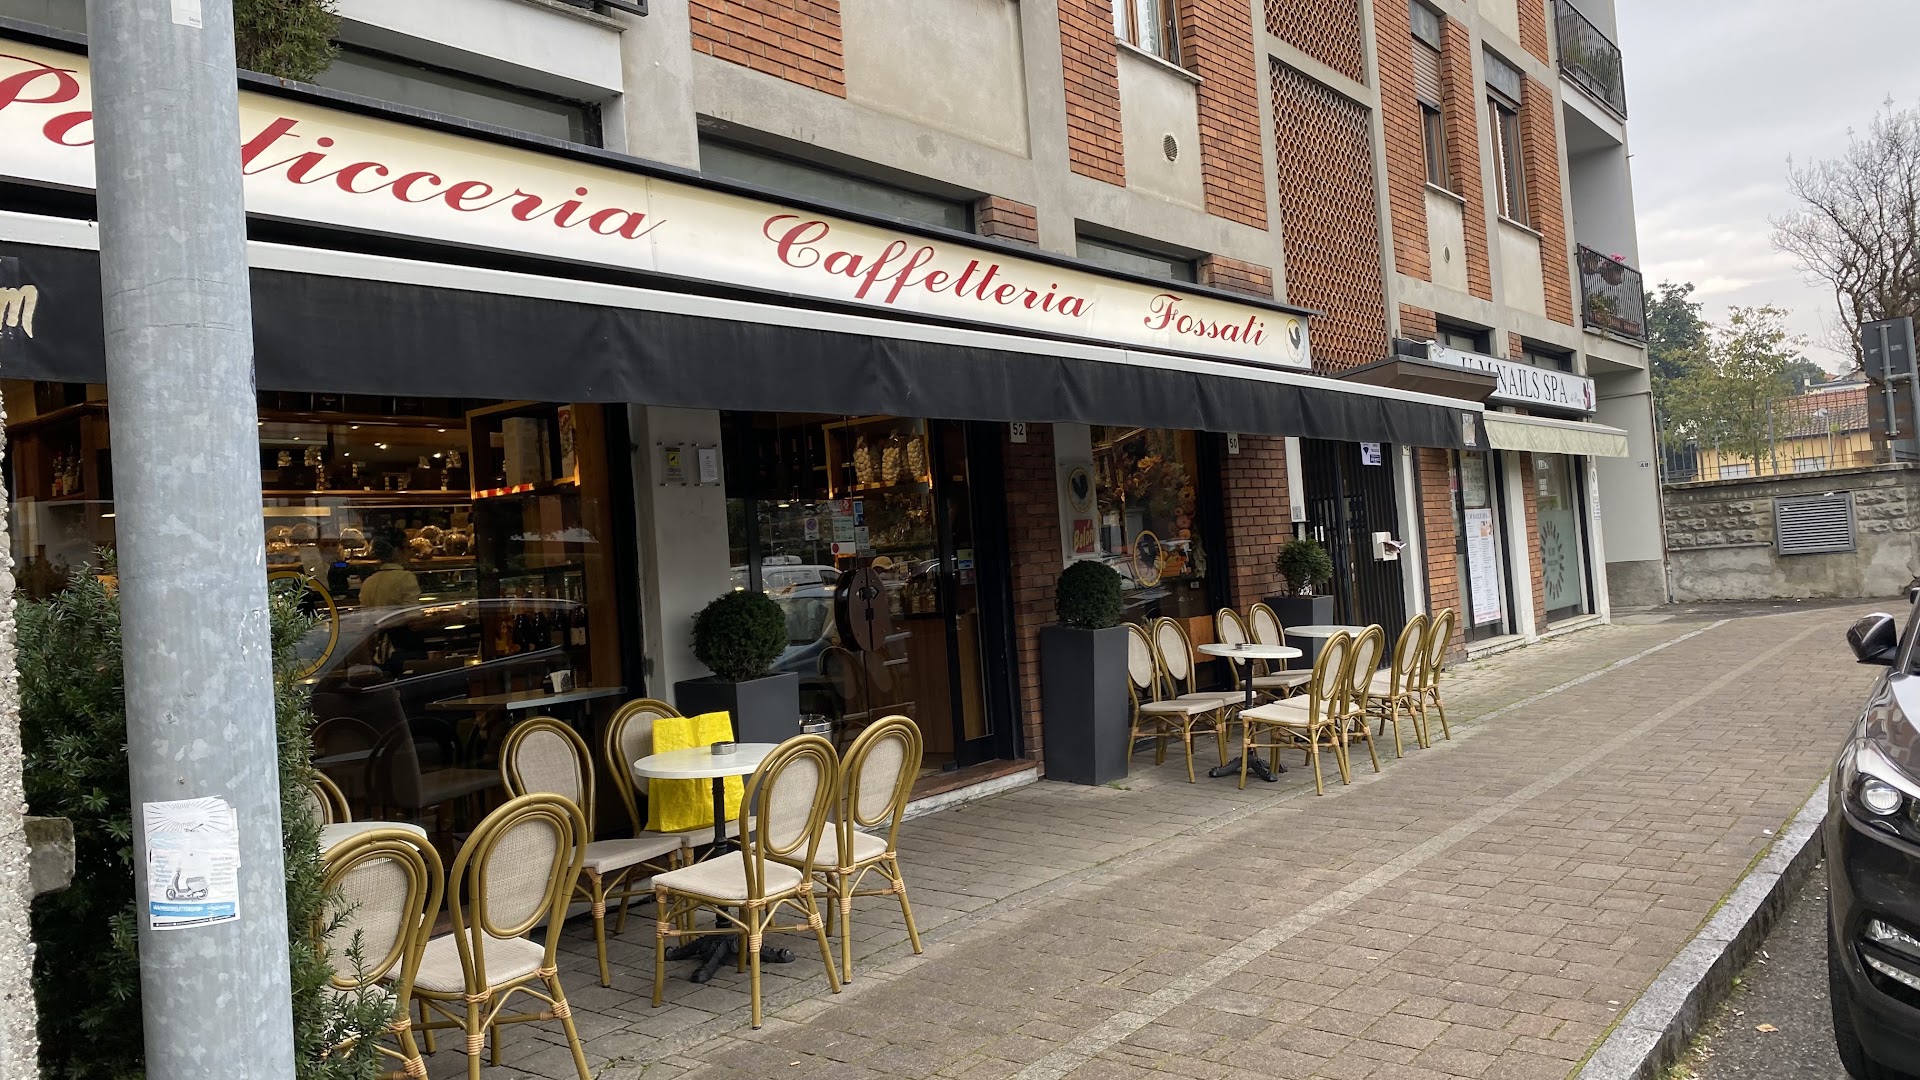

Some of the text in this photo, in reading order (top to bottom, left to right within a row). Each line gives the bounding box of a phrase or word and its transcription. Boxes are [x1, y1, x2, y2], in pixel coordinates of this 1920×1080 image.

[0, 54, 1269, 346] Paticceria Caffetteria Fossati
[1496, 365, 1540, 400] NAILS
[1543, 373, 1569, 404] SPA
[1013, 423, 1024, 435] 52
[1229, 438, 1238, 449] 50
